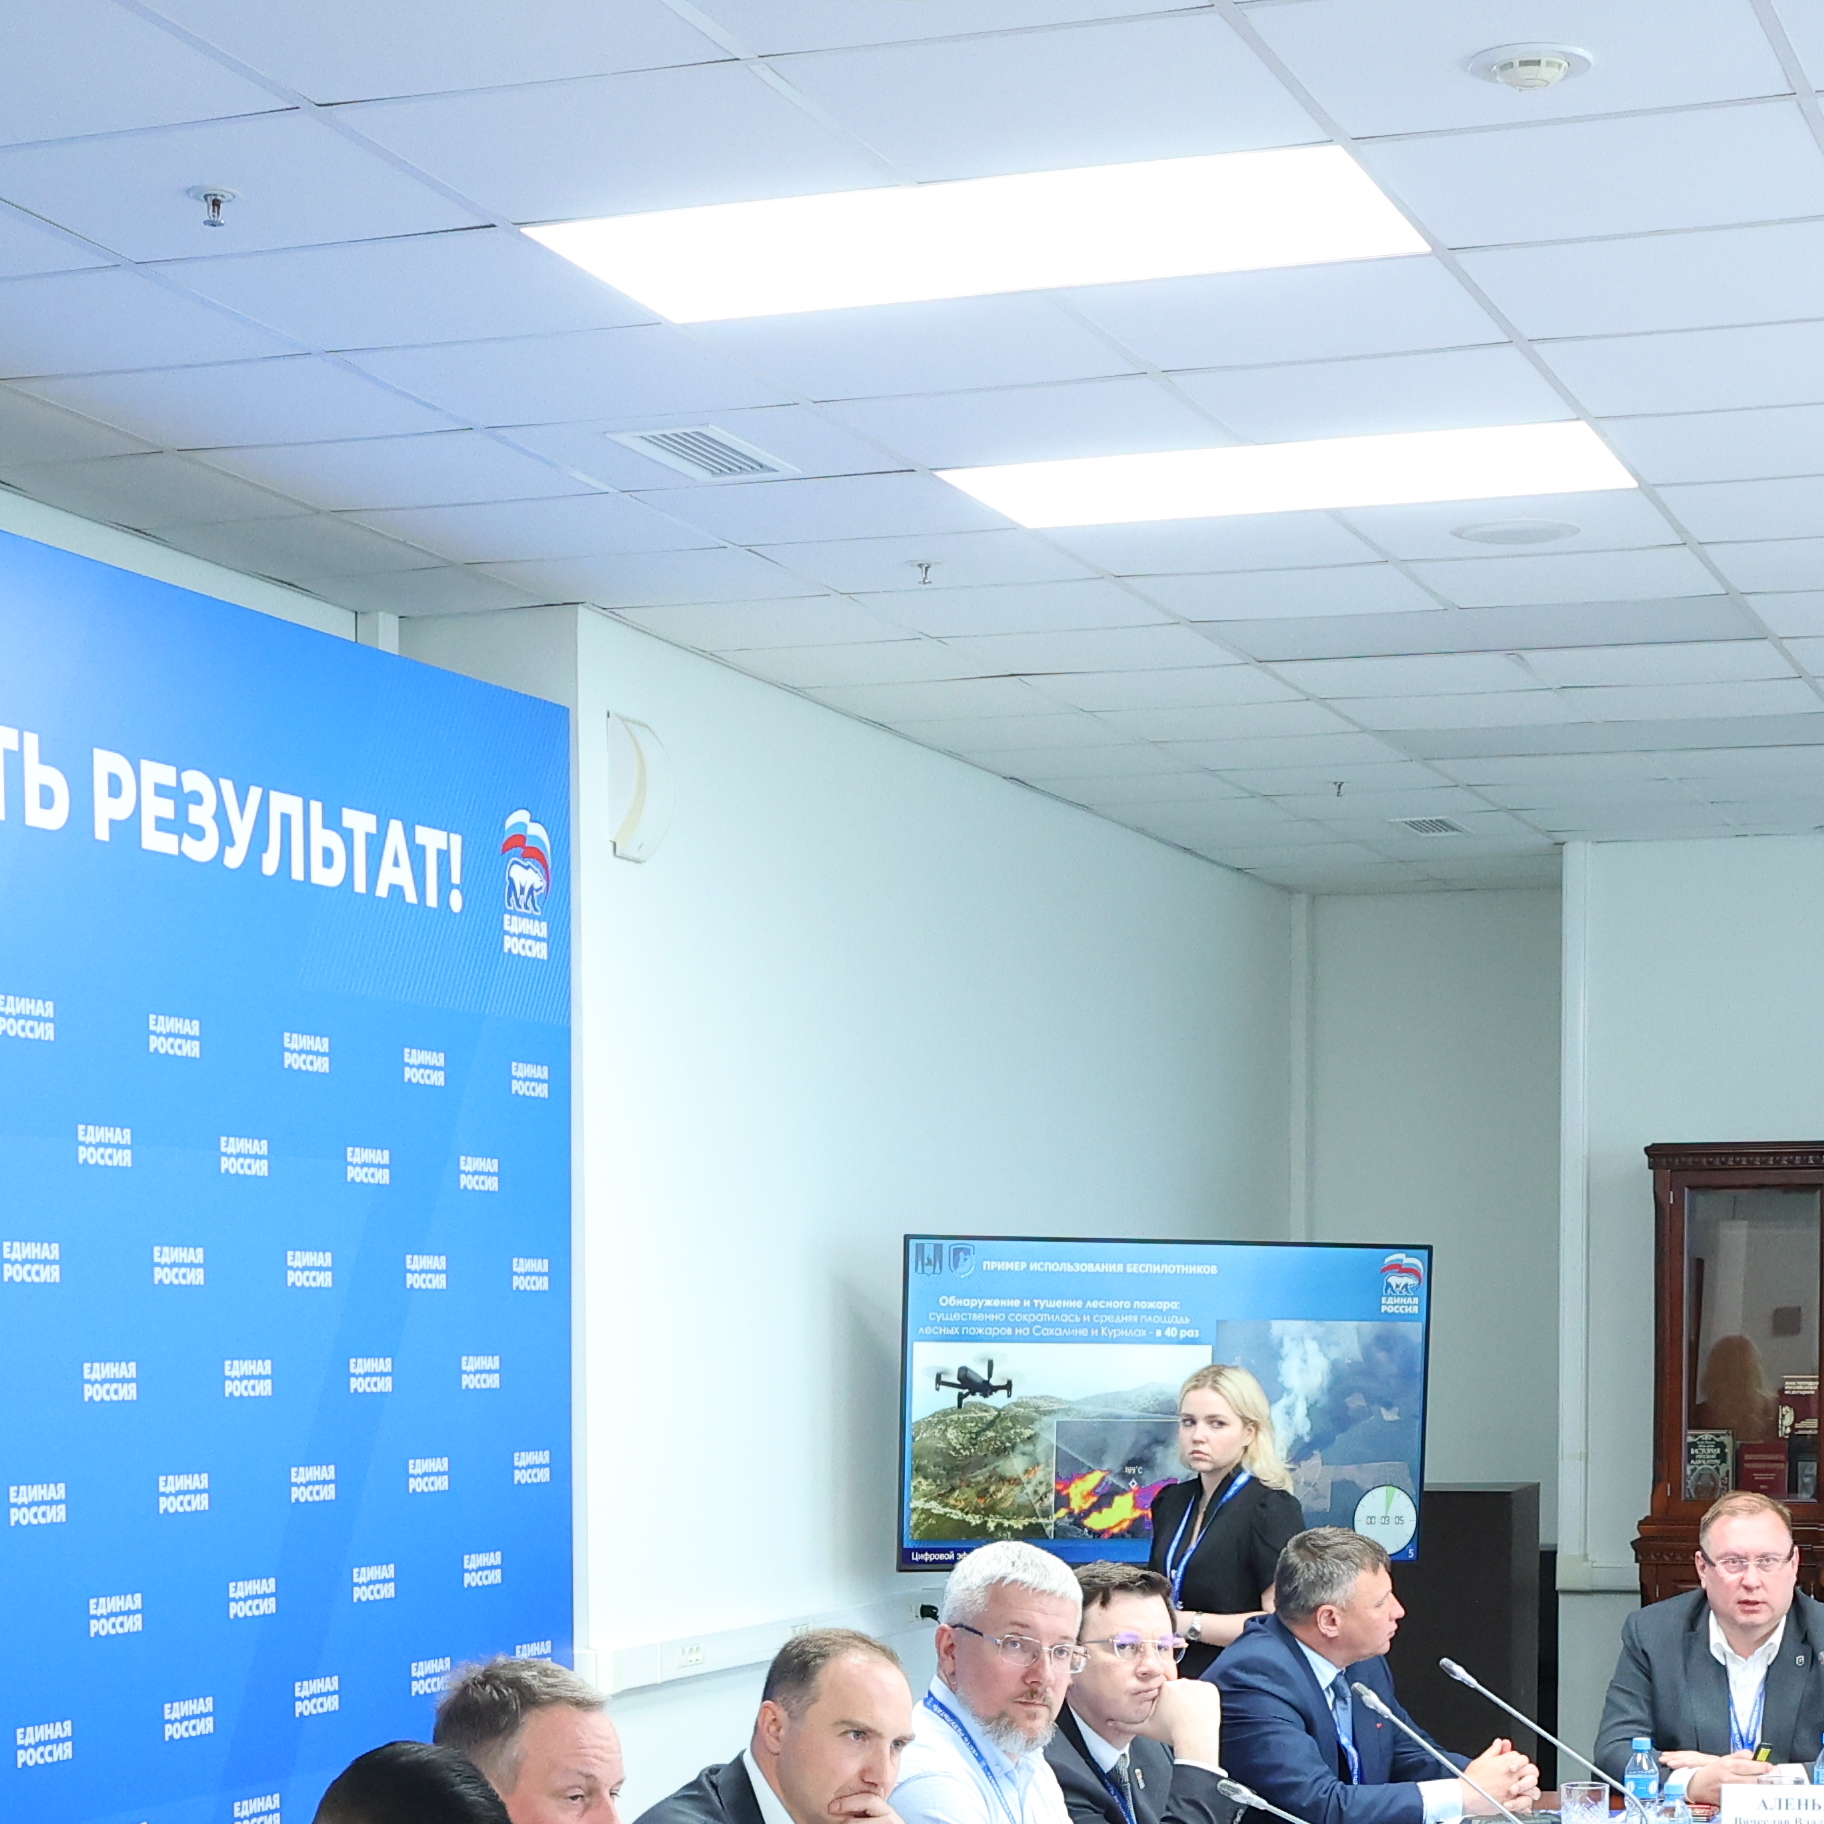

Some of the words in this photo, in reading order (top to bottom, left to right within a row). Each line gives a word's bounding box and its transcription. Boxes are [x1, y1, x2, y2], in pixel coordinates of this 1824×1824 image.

[93, 748, 464, 913] РЕЗУЛЬТАТ!
[503, 914, 548, 938] ЕДИНАЯ
[503, 934, 548, 960] РОССИЯ
[283, 1032, 330, 1053] ЕДИНАЯ
[284, 1052, 330, 1073] РОССИЯ
[459, 1155, 498, 1173] ЕДИНАЯ
[459, 1173, 499, 1191] РОССИЯ
[3, 1241, 60, 1261] ЕДИНАЯ
[3, 1263, 60, 1283] РОССИЯ
[982, 1260, 1027, 1272] ПРИМЕР
[1029, 1261, 1124, 1274] ИСПОЛЬЗОВАНИЯ
[1126, 1263, 1218, 1276] БЕСПИЛОТНИКОВ
[939, 1295, 1021, 1311] Обнаружение
[1033, 1299, 1083, 1311] тушение
[1085, 1299, 1132, 1310] лесного
[1381, 1296, 1419, 1304] ЕДИНАЯ
[1381, 1305, 1419, 1313] РОССИЯ
[928, 1312, 1006, 1326] существенно
[1008, 1313, 1081, 1326] сократилась
[1093, 1315, 1138, 1326] средняя
[1139, 1316, 1191, 1327] площадь
[918, 1327, 960, 1337] лесных
[961, 1327, 1012, 1339] пожаров
[1014, 1328, 1030, 1337] на
[1031, 1325, 1088, 1338] Сахалине
[1100, 1327, 1147, 1340] Курилах
[1164, 1328, 1178, 1339] 40
[1179, 1330, 1200, 1341] раз
[461, 1355, 500, 1372] ЕДИНАЯ
[461, 1373, 500, 1390] РОССИЯ
[514, 1450, 550, 1468] ЕДИНАЯ
[291, 1465, 335, 1484] ЕДИНАЯ
[514, 1467, 550, 1484] РОССИЯ
[9, 1483, 66, 1505] ЕДИНАЯ
[291, 1483, 336, 1503] РОССИЯ
[10, 1504, 66, 1526] РОССИЯ
[463, 1551, 501, 1570] ЕДИНАЯ
[911, 1550, 955, 1563] Цифровой
[1408, 1549, 1414, 1558] 5
[464, 1569, 501, 1588] РОССИЯ
[411, 1657, 451, 1678] ЕДИНАЯ
[411, 1677, 448, 1696] РОССИ
[16, 1720, 72, 1746] ЕДИНАЯ
[17, 1741, 73, 1768] РОССИЯ
[233, 1793, 280, 1818] ЕДИНАЯ
